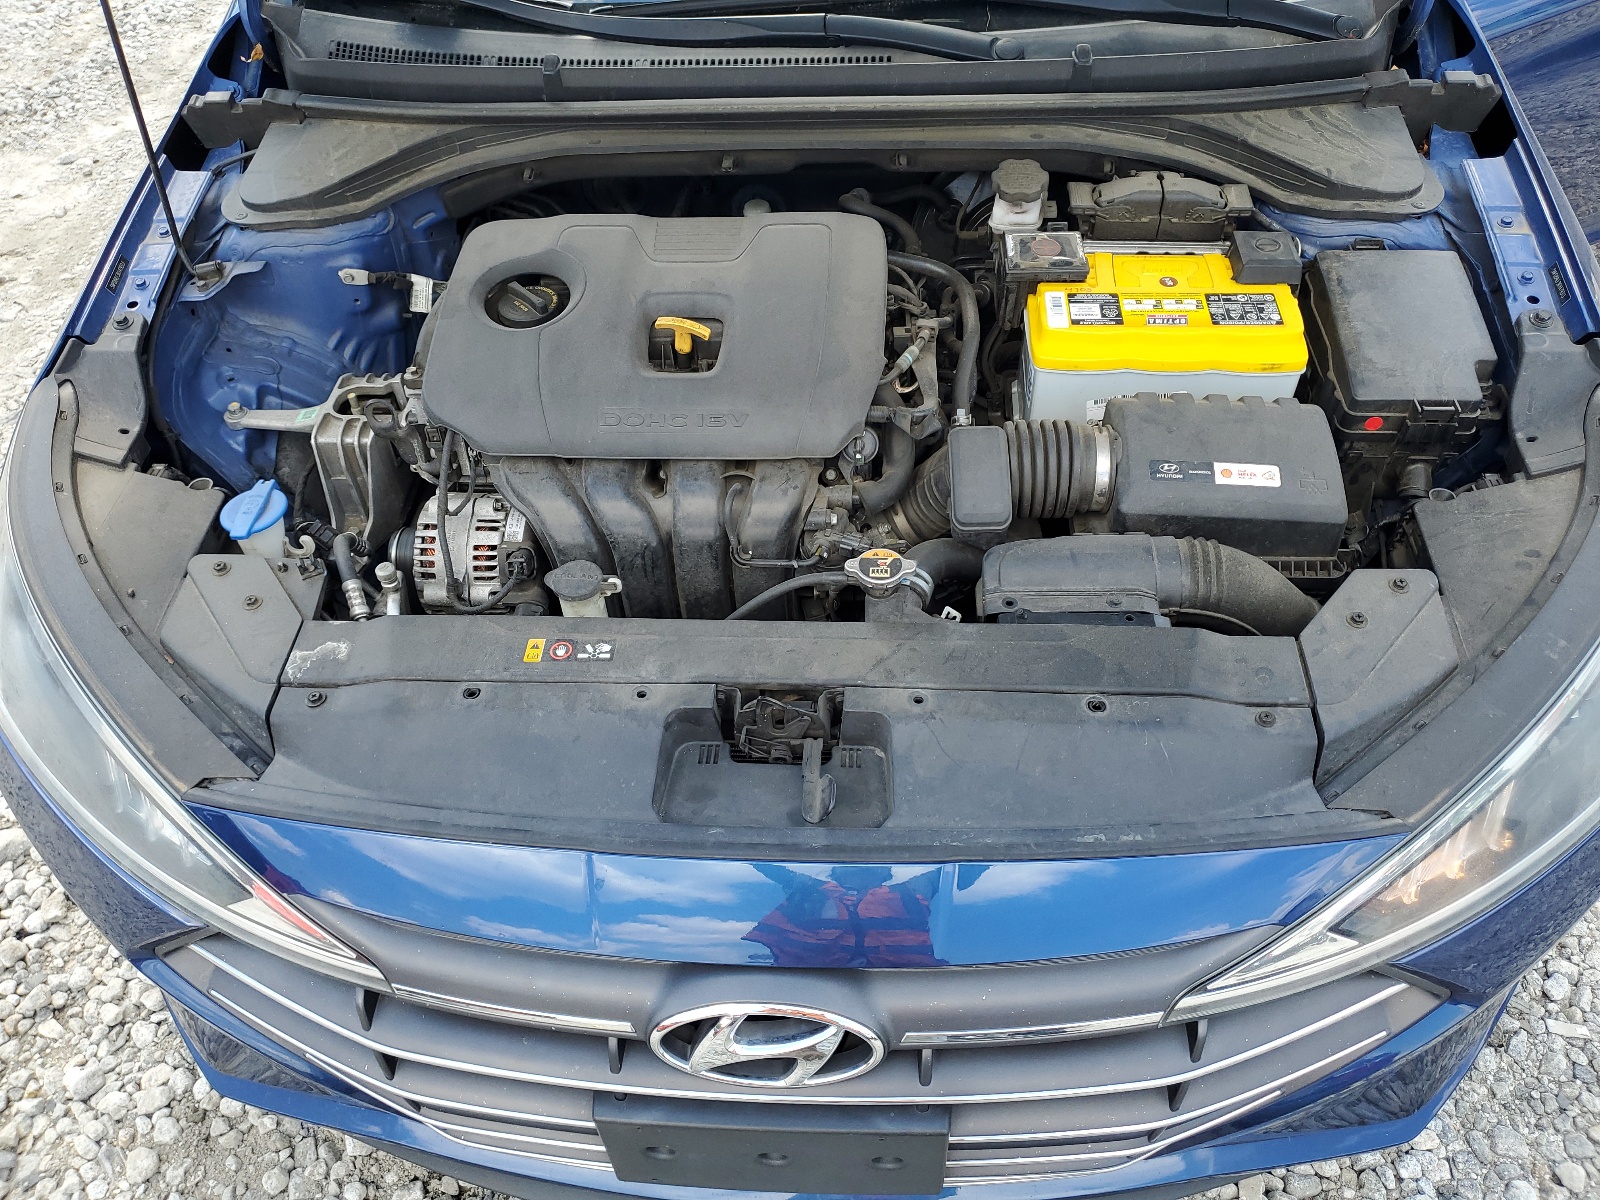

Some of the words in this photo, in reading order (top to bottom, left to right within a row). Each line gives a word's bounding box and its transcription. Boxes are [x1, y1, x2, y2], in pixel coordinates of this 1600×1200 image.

[599, 412, 688, 428] DOHC
[697, 413, 749, 428] 16V
[554, 572, 599, 580] COOLANT
